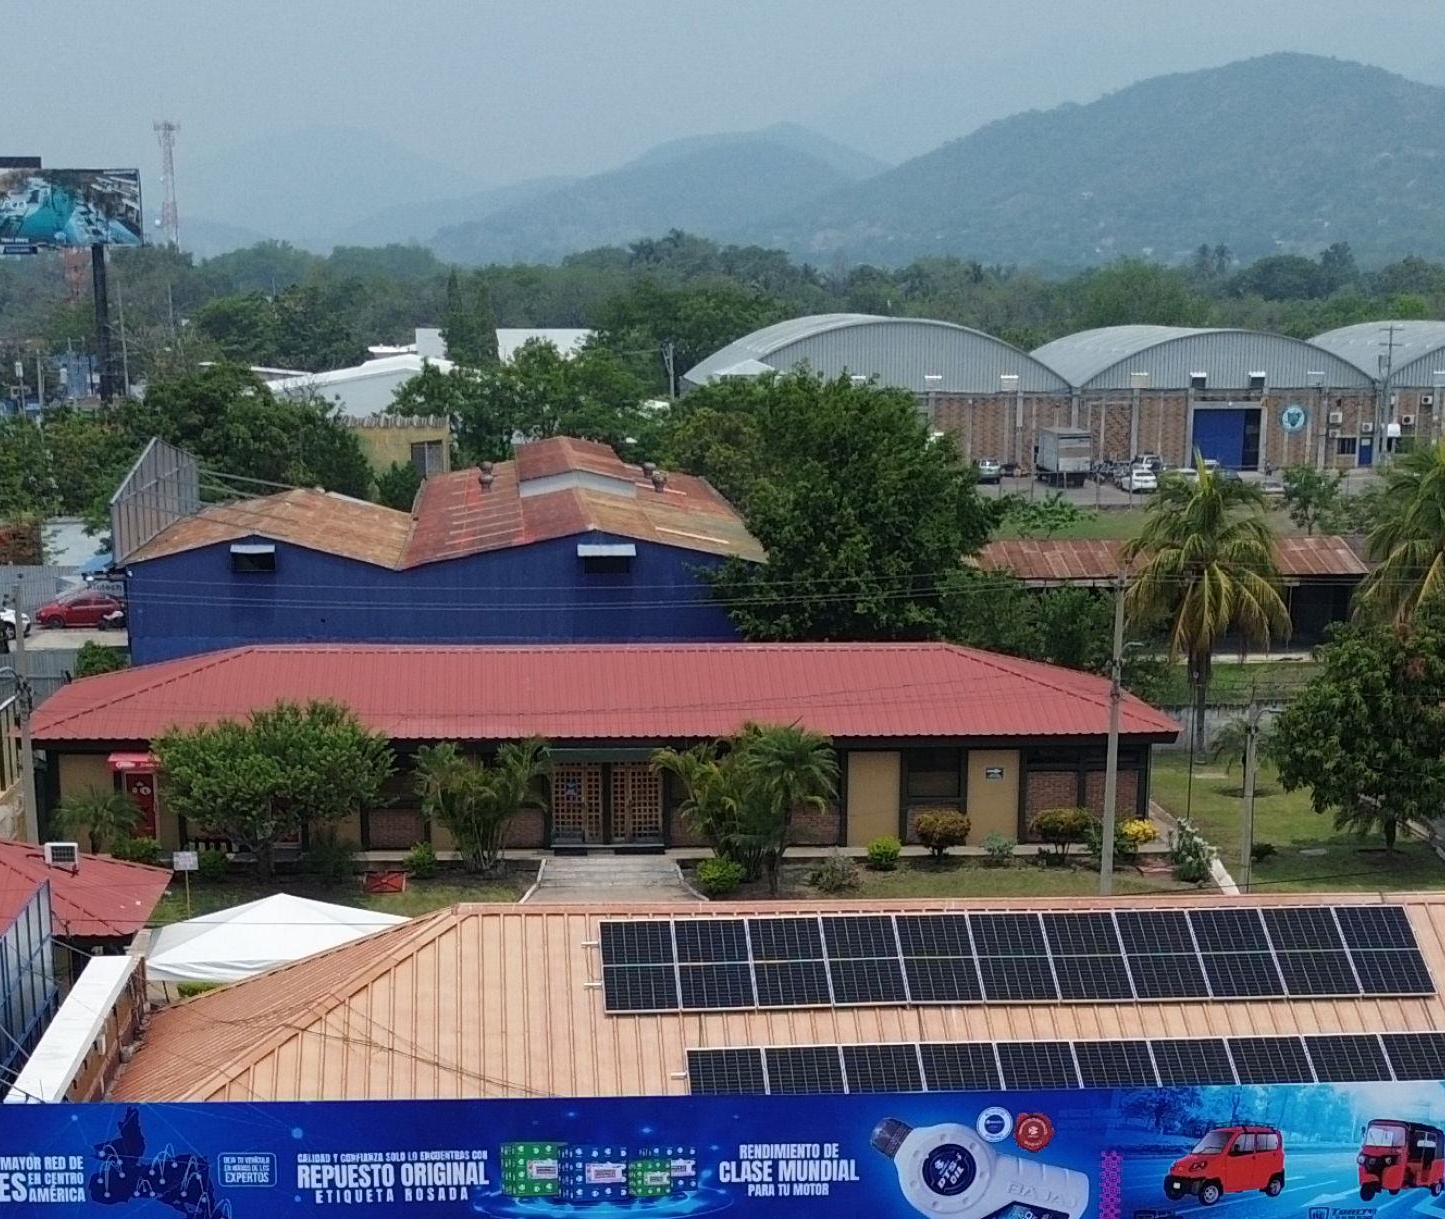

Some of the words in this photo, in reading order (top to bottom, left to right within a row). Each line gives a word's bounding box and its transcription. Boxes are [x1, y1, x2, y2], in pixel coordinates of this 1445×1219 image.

[297, 1152, 331, 1164] CALIDAD
[333, 1152, 339, 1163] Y
[385, 1150, 406, 1161] SOLO
[407, 1150, 418, 1161] LO
[419, 1150, 470, 1162] ENCUENTRAS
[471, 1150, 488, 1161] CON
[739, 1143, 820, 1160] RENDIMIENTO
[823, 1143, 839, 1159] DE
[0, 1155, 41, 1171] MAYOR
[44, 1155, 65, 1171] RED
[68, 1155, 84, 1170] DE
[719, 1160, 774, 1183] CLASE
[778, 1159, 860, 1182] MUNDIAL
[28, 1173, 43, 1186] EN
[45, 1171, 85, 1186] CENTRO
[224, 1171, 270, 1184] EXPERTOS
[297, 1162, 396, 1189] REPUESTO
[400, 1161, 490, 1187] ORIGINAL
[29, 1184, 86, 1203] AMÉRICA
[315, 1188, 395, 1204] ETIQUETA
[405, 1186, 469, 1202] ROSADA
[747, 1183, 774, 1197] PARA
[777, 1183, 790, 1197] TU
[793, 1182, 830, 1197] MOTOR
